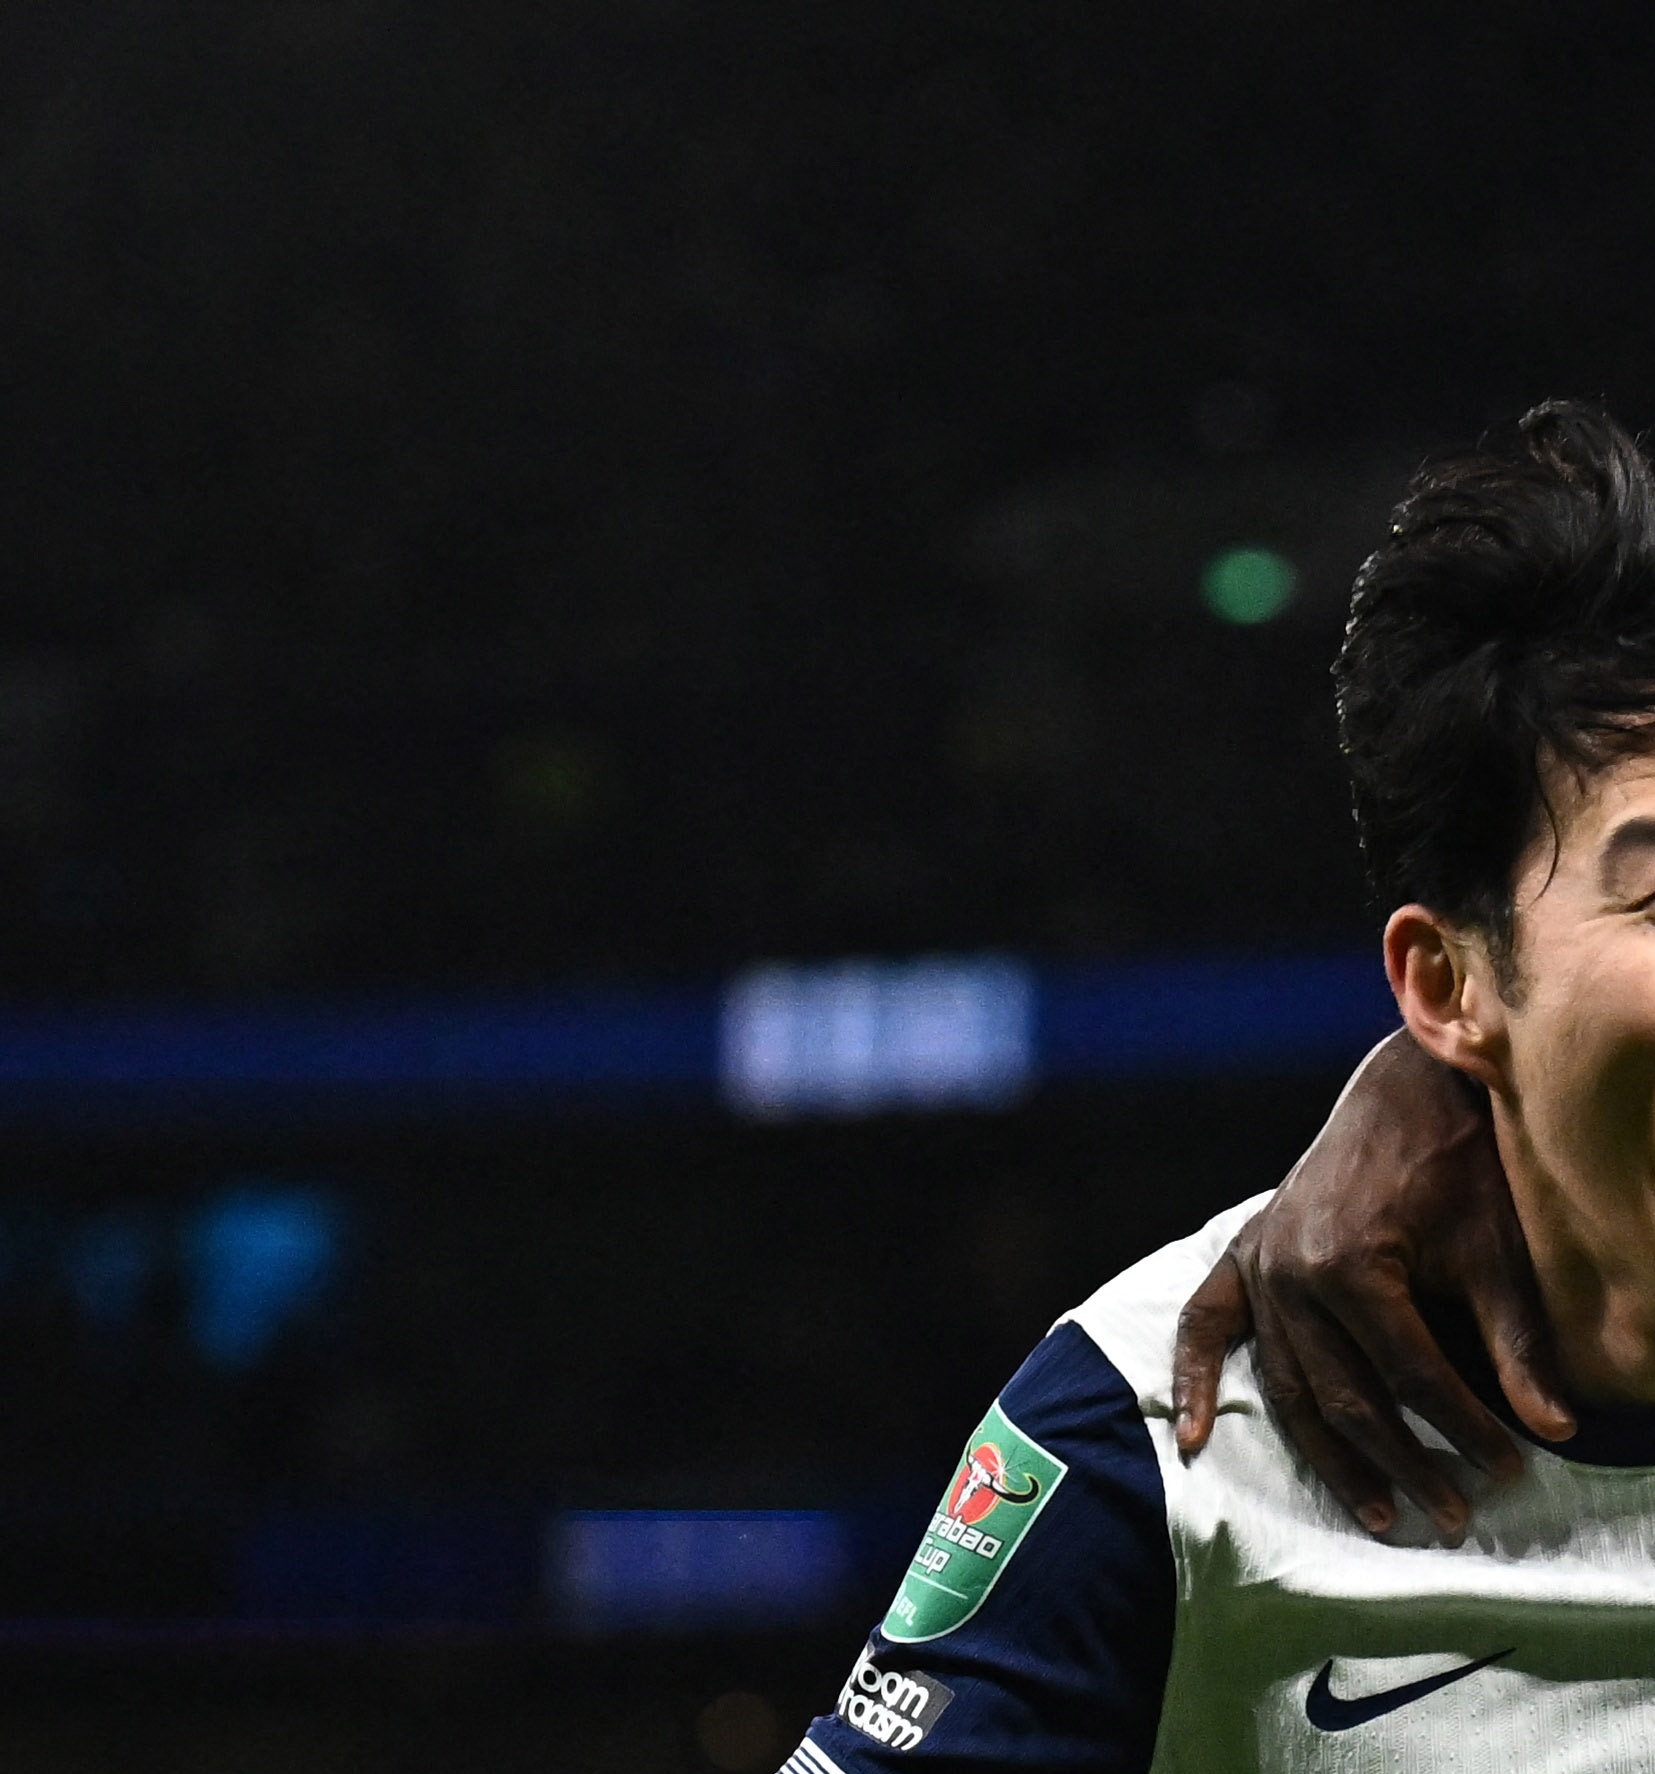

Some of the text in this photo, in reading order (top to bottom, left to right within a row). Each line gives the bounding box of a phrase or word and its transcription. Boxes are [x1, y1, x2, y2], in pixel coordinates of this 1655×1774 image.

[914, 1536, 951, 1575] Cup
[928, 1511, 1004, 1560] arabao
[896, 1596, 918, 1627] EFL
[851, 1656, 930, 1719] oom
